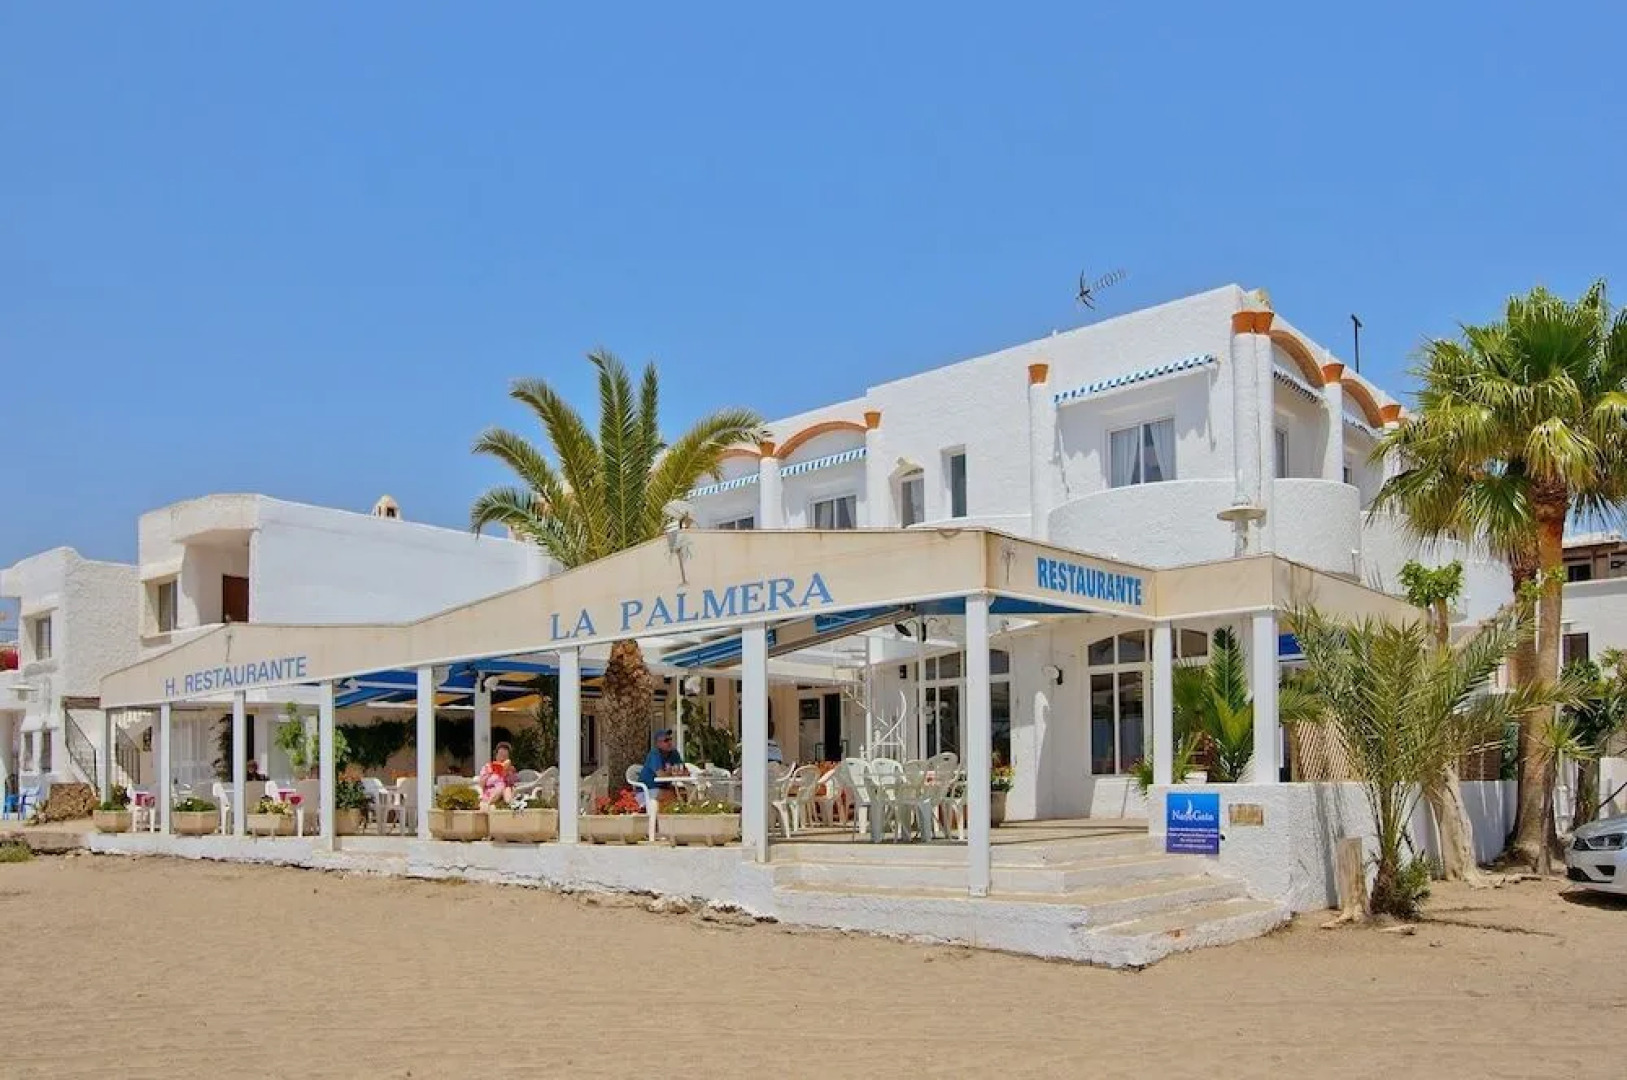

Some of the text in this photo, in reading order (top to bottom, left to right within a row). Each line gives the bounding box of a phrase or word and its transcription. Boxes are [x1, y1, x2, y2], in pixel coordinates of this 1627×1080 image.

[1037, 555, 1142, 606] RESTAURANTE
[549, 572, 834, 641] LA PALMERA
[165, 656, 307, 698] H. RESTAURANTE
